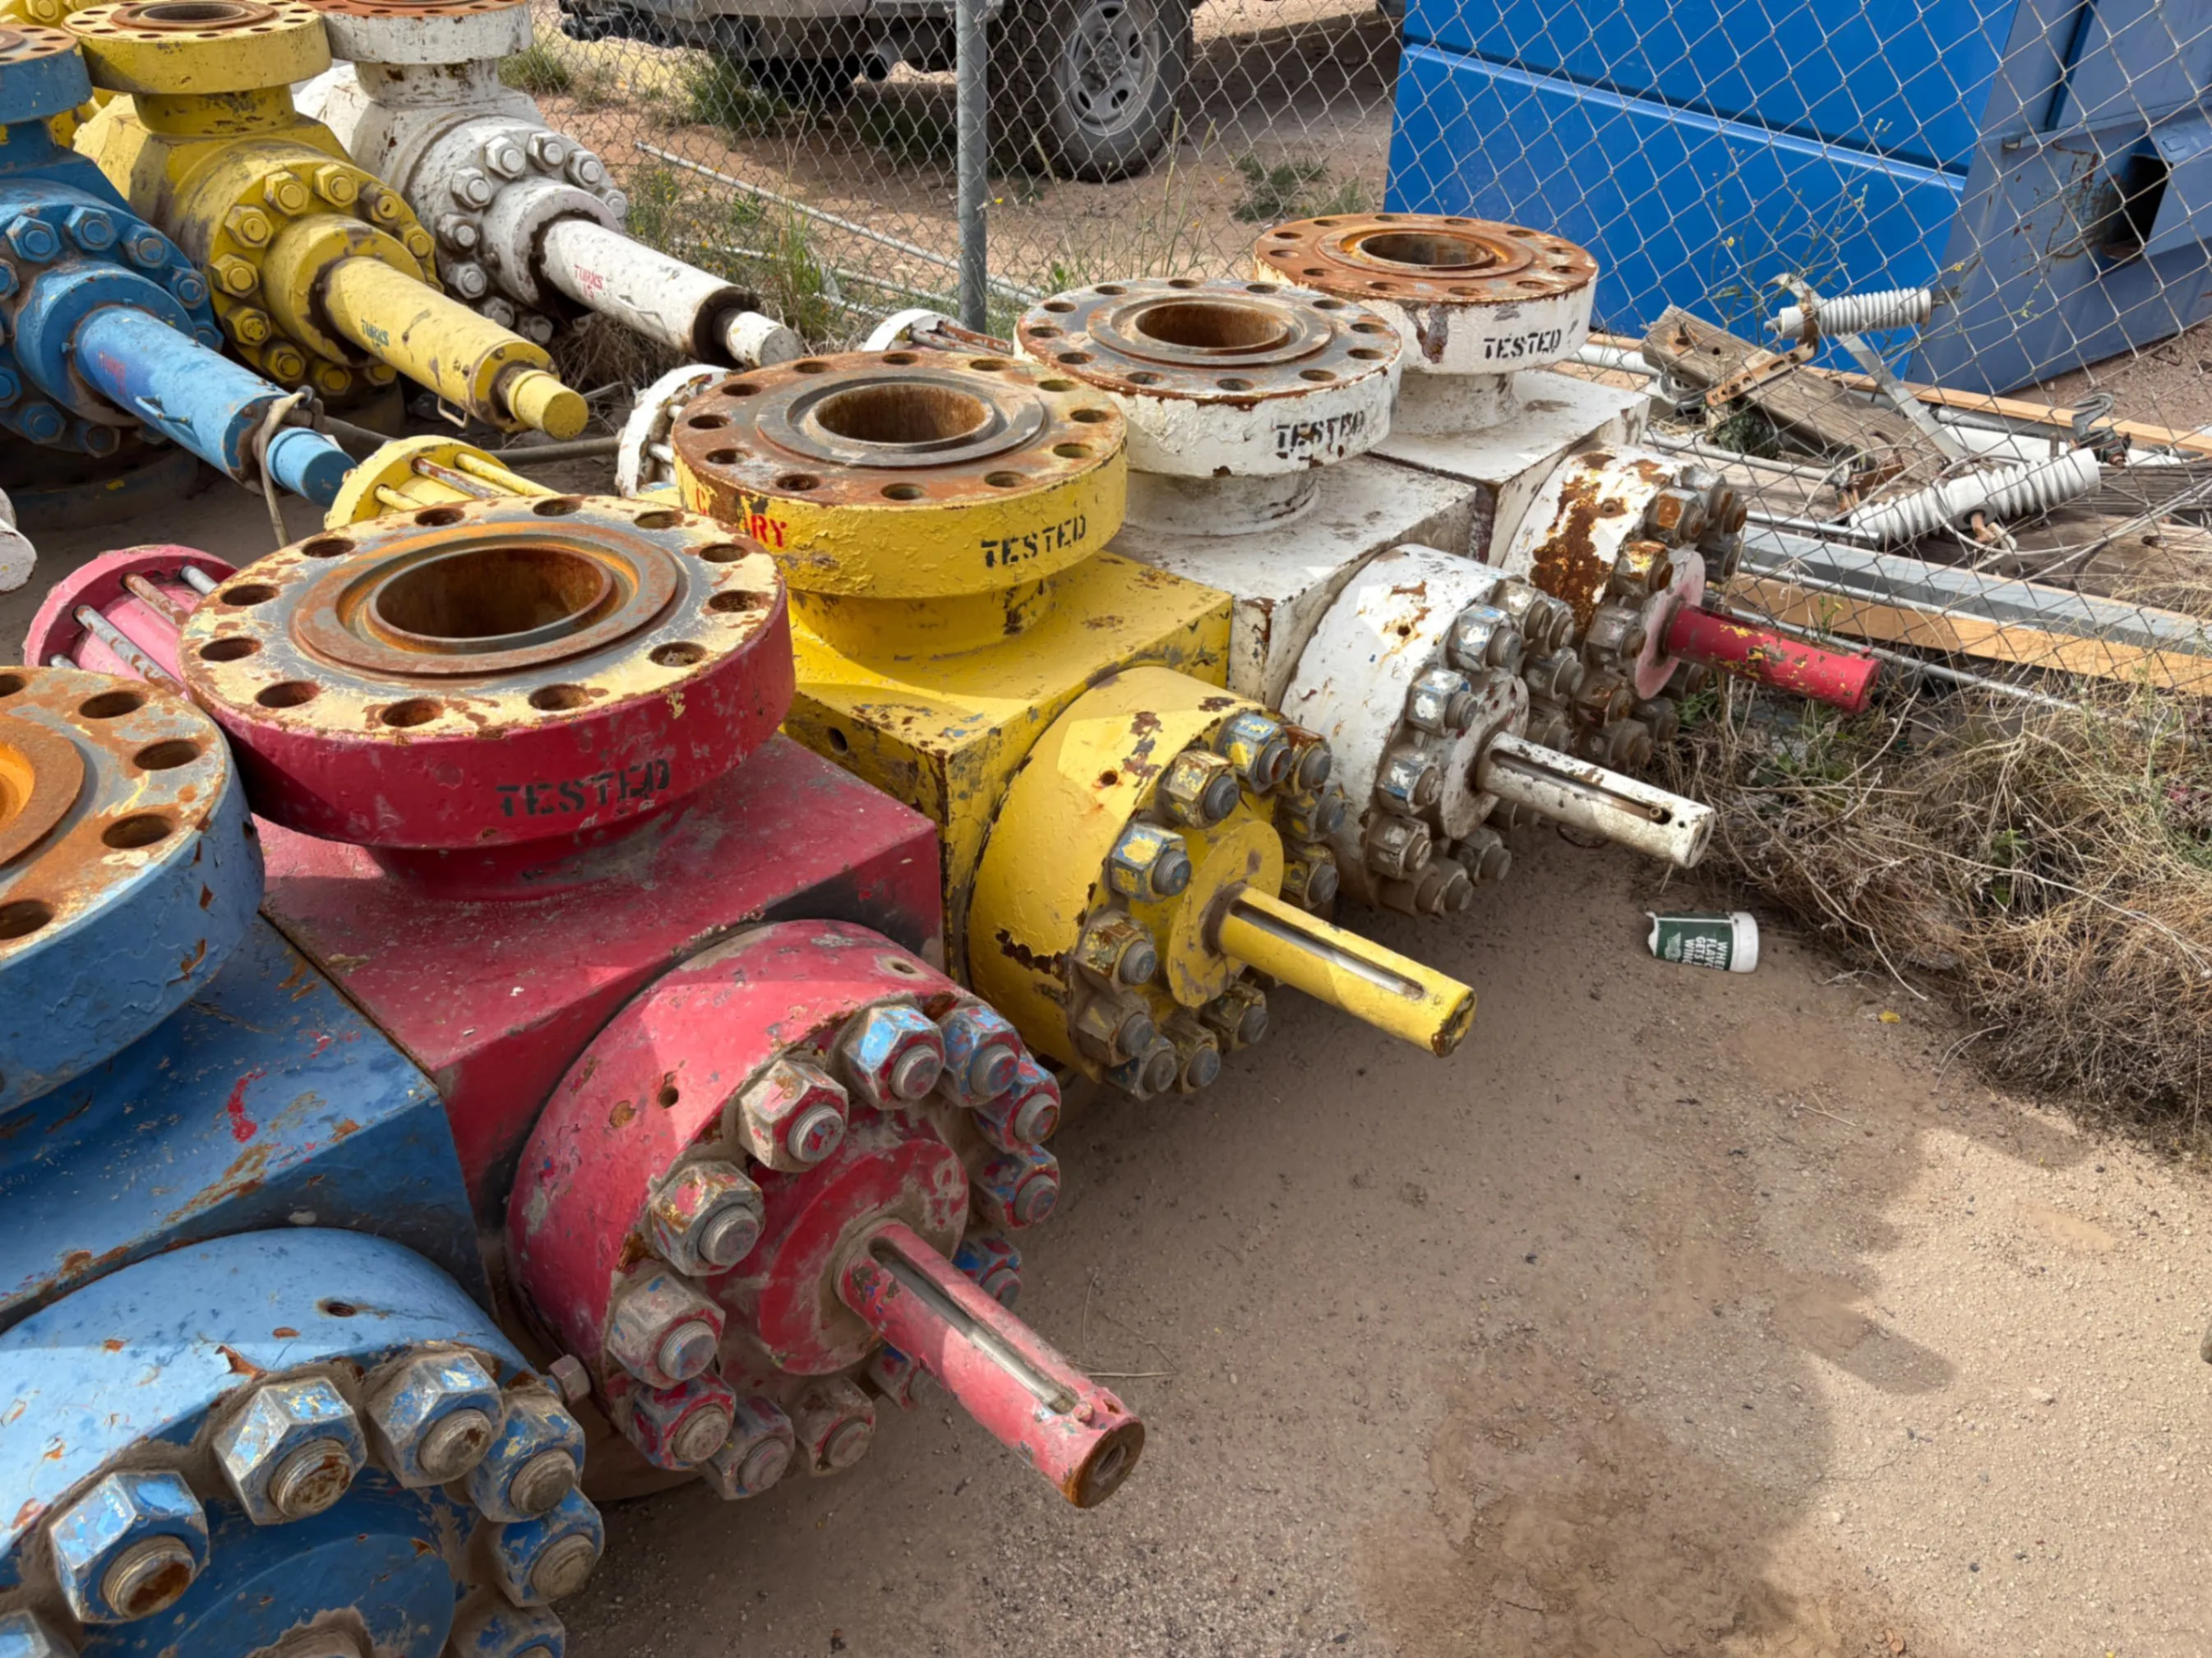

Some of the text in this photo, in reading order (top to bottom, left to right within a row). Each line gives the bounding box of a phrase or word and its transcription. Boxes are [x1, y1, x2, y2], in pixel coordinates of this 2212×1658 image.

[1484, 329, 1562, 360] TESTED
[1276, 410, 1365, 449] TESTED
[981, 515, 1086, 569] TESTED
[496, 759, 670, 818] TESTED
[1693, 935, 1706, 961] GETS
